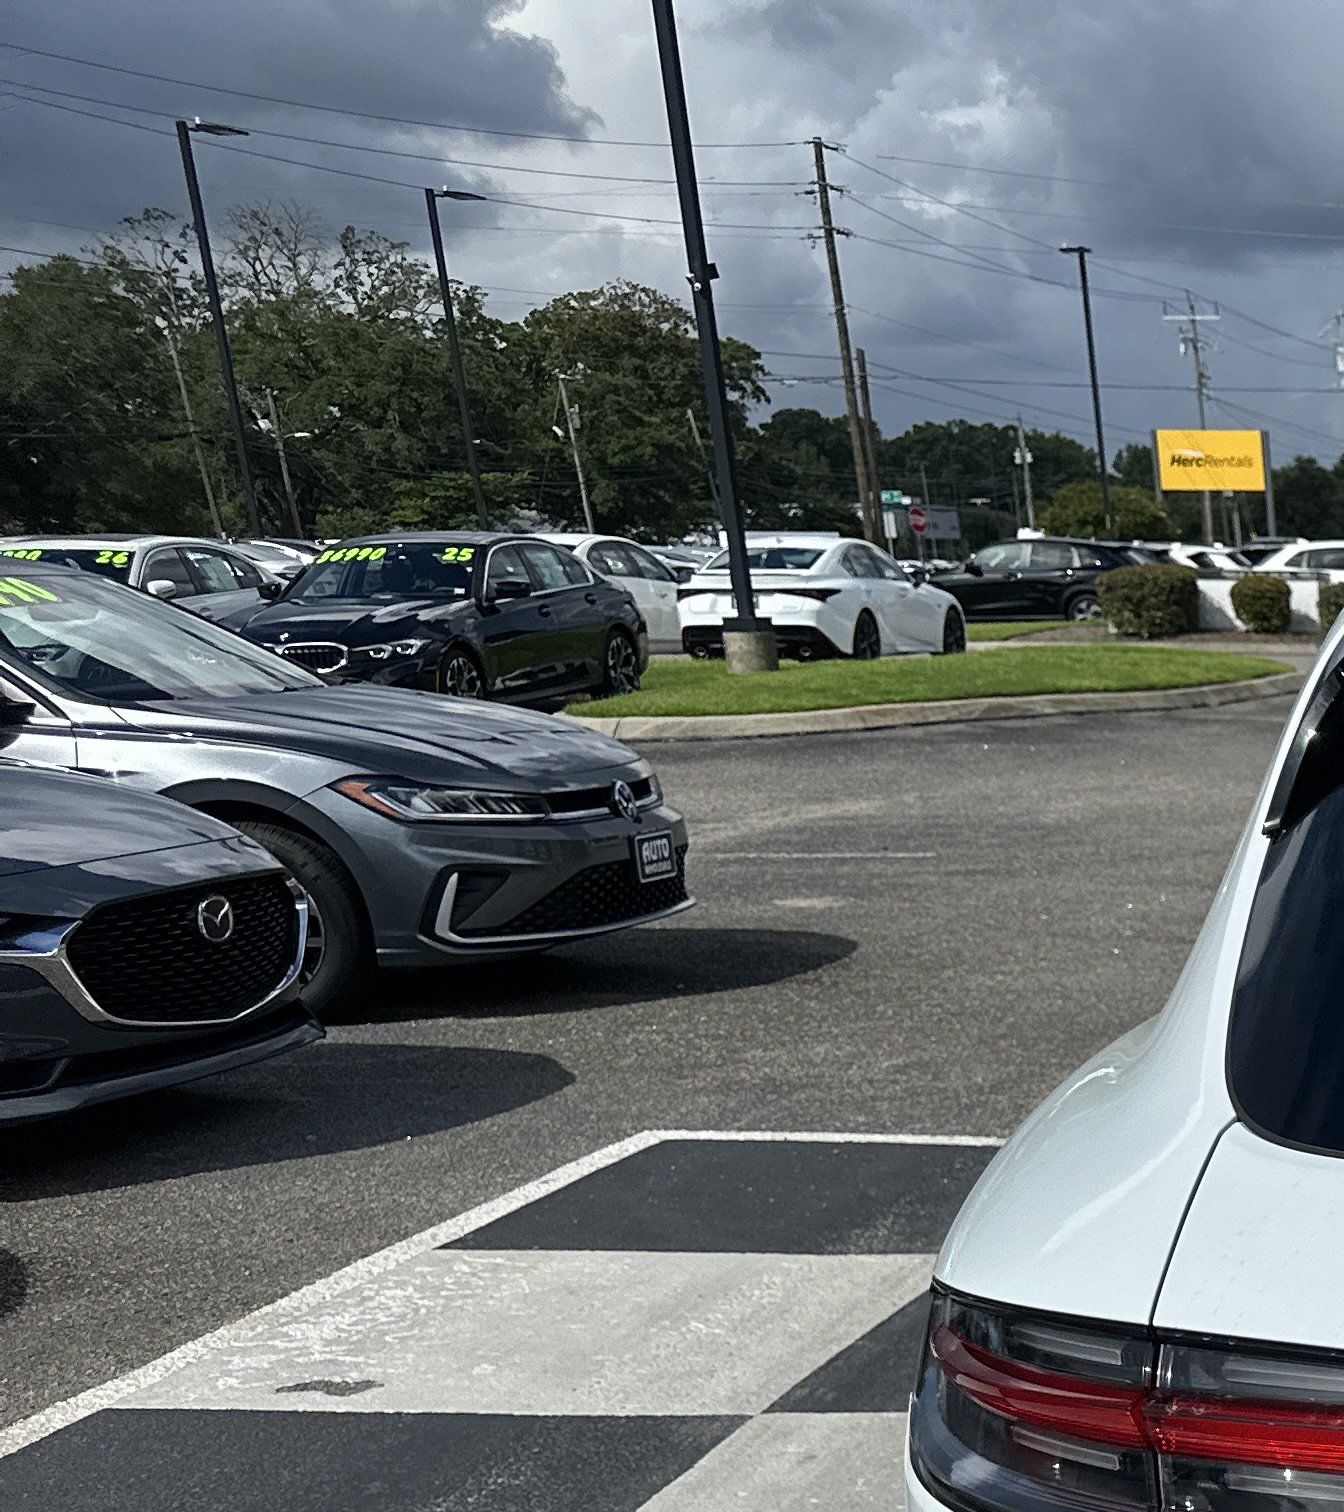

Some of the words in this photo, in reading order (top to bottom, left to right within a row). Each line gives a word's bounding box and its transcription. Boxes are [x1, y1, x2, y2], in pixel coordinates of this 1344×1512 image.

[95, 550, 129, 564] 26
[441, 547, 475, 561] 25
[641, 838, 670, 865] AUTO
